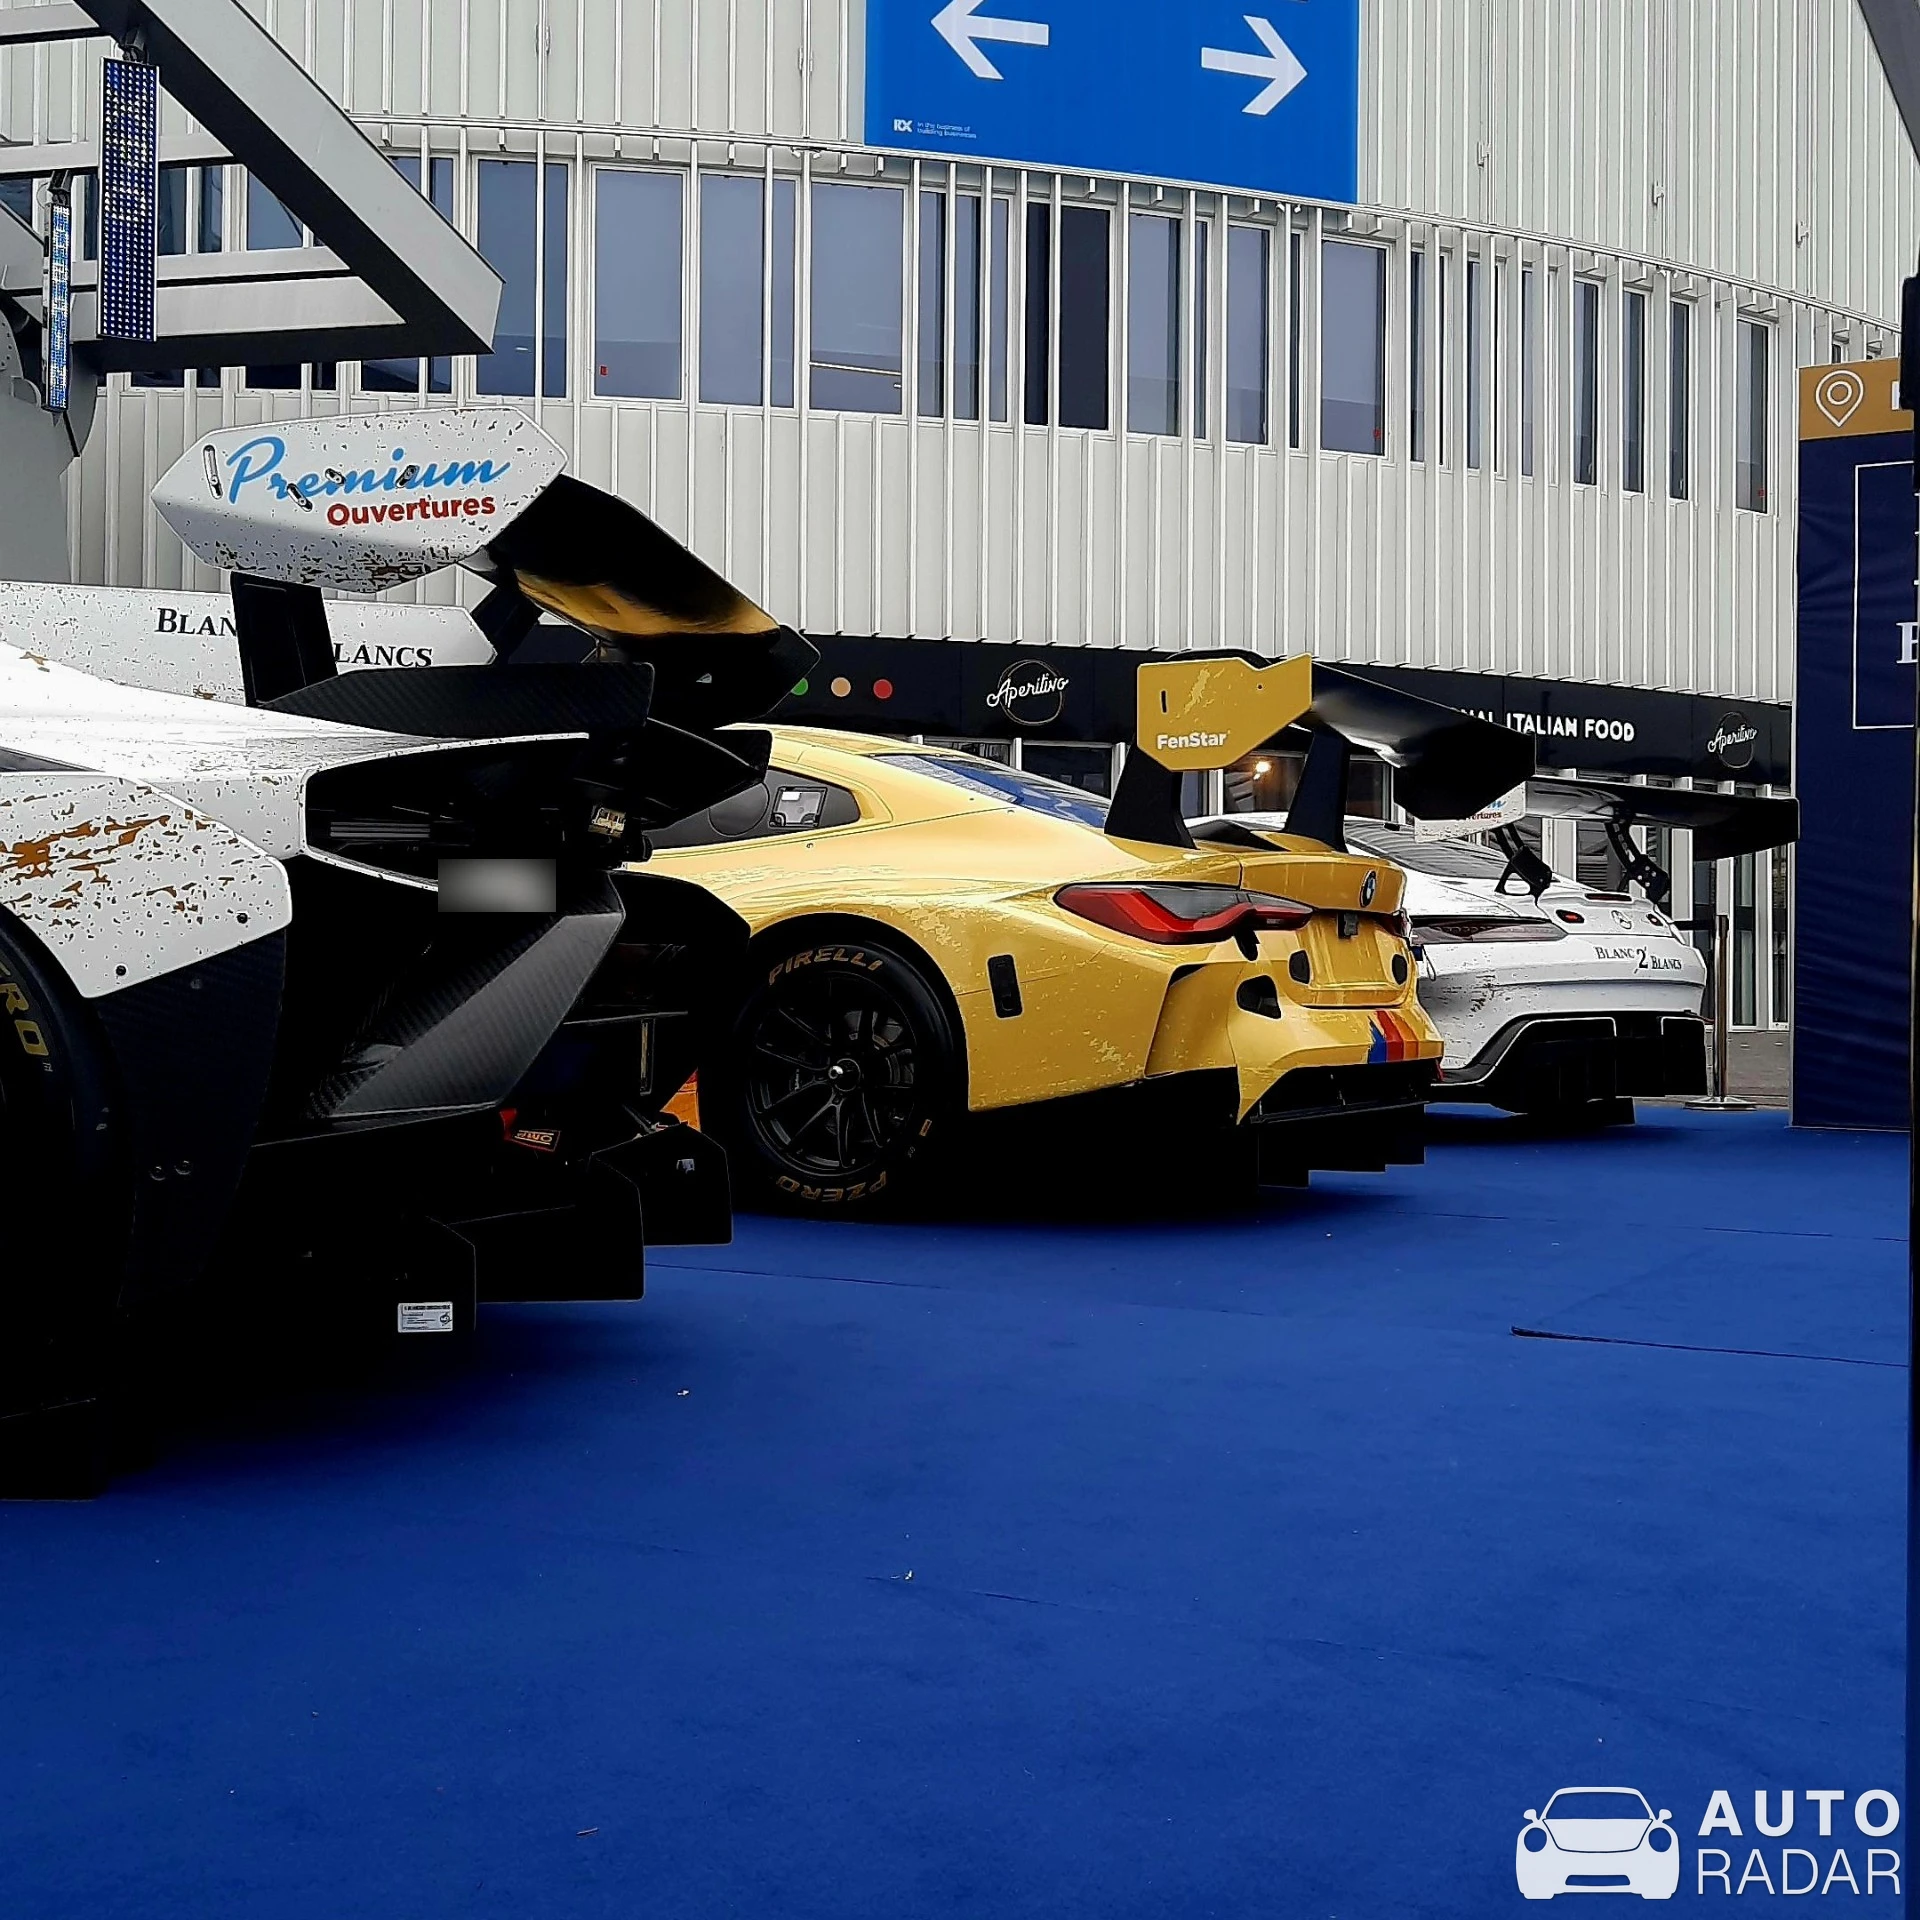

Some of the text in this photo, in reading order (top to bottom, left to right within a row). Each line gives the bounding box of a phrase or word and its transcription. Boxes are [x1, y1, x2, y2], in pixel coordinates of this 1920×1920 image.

[226, 436, 511, 504] Premium
[326, 495, 496, 527] Ouvertures
[155, 607, 237, 637] BLAN
[333, 642, 433, 667] LANCS
[986, 673, 1070, 709] Aperitivo
[1157, 731, 1228, 751] FenStar
[1506, 712, 1578, 737] ITALIAN
[1585, 718, 1635, 742] FOOD
[1707, 724, 1758, 754] Aperitivo
[768, 947, 884, 986] PIRELLI
